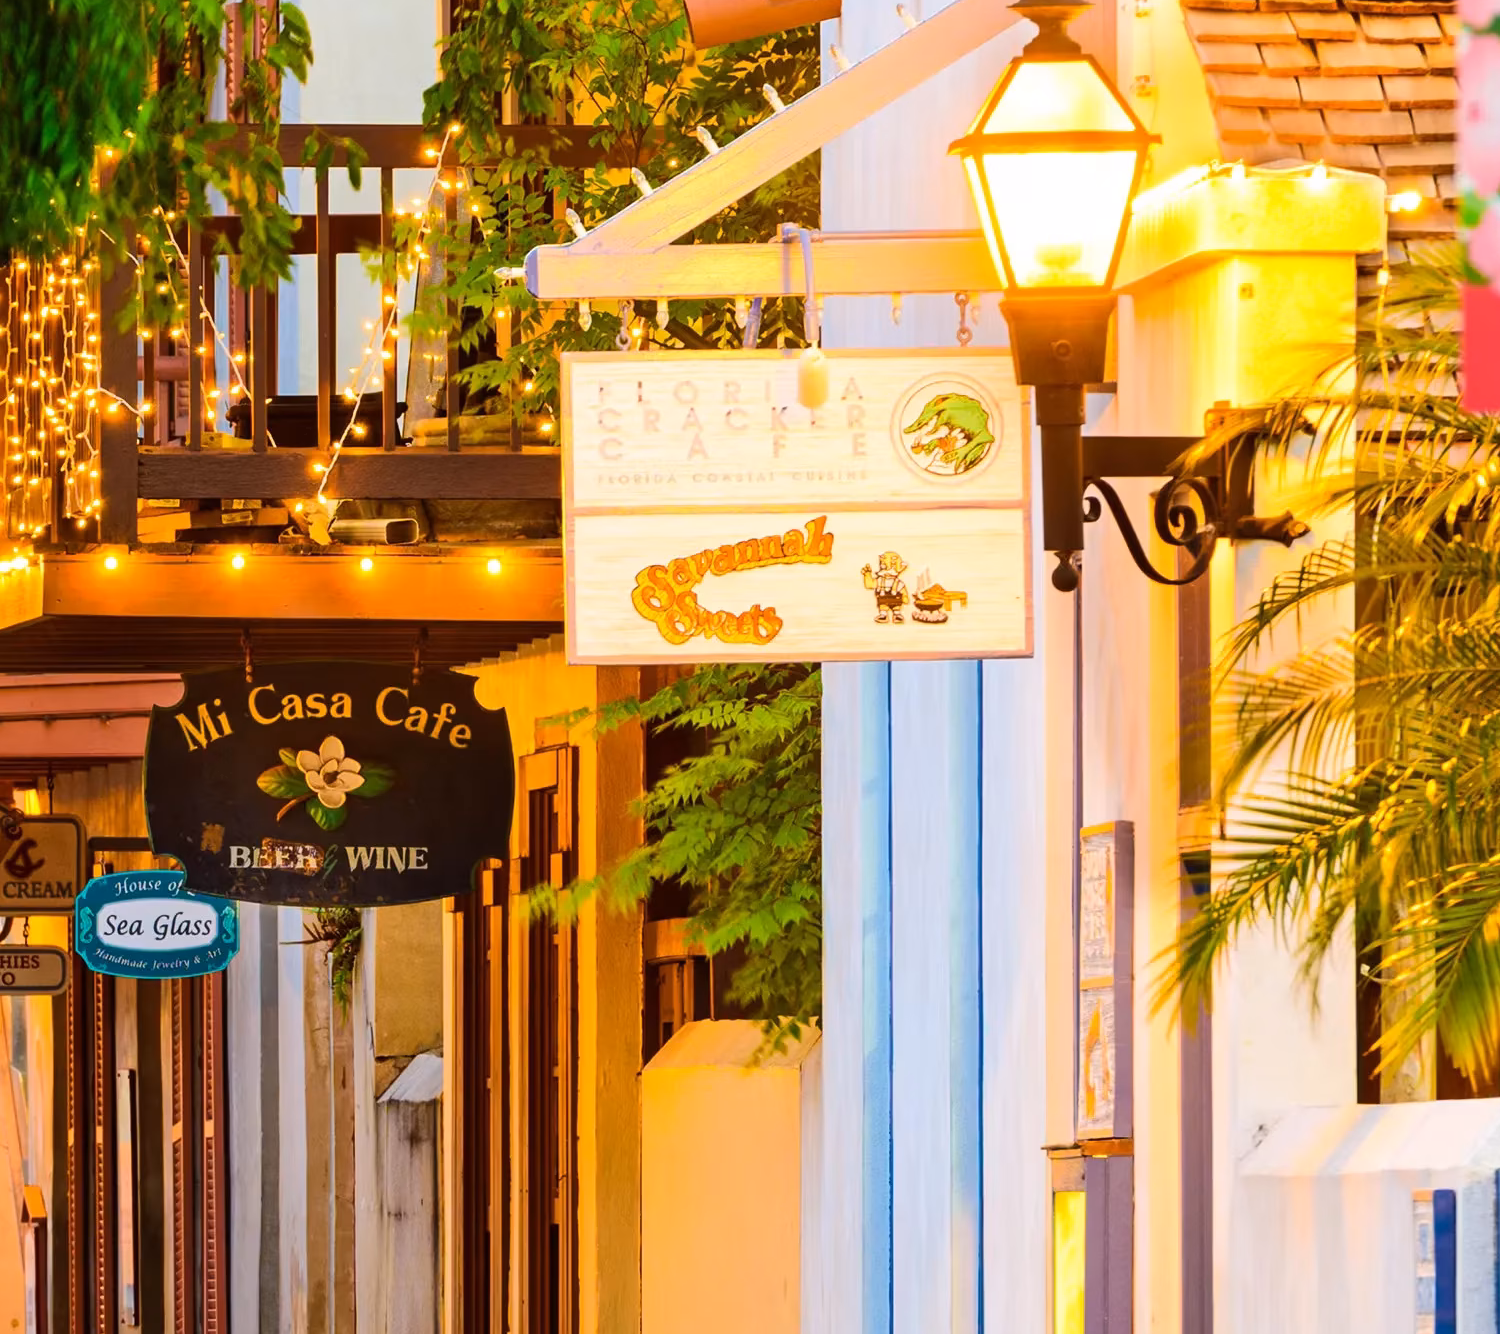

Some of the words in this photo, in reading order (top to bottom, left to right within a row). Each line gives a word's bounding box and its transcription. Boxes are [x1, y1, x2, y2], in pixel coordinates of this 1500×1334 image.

[598, 376, 864, 404] FLORIA
[633, 514, 835, 612] Savannah
[657, 589, 784, 645] Sweets
[175, 698, 234, 753] Mi
[248, 683, 353, 726] Casa
[376, 686, 473, 749] Cafe
[229, 844, 319, 869] BEER
[344, 846, 429, 874] WINE
[3, 882, 74, 900] CREAM
[115, 877, 162, 897] House
[168, 878, 183, 897] of
[103, 914, 145, 937] Sea
[153, 911, 213, 941] Glass
[93, 948, 148, 970] Handmade
[152, 958, 191, 971] Jewelry
[206, 947, 223, 962] Art
